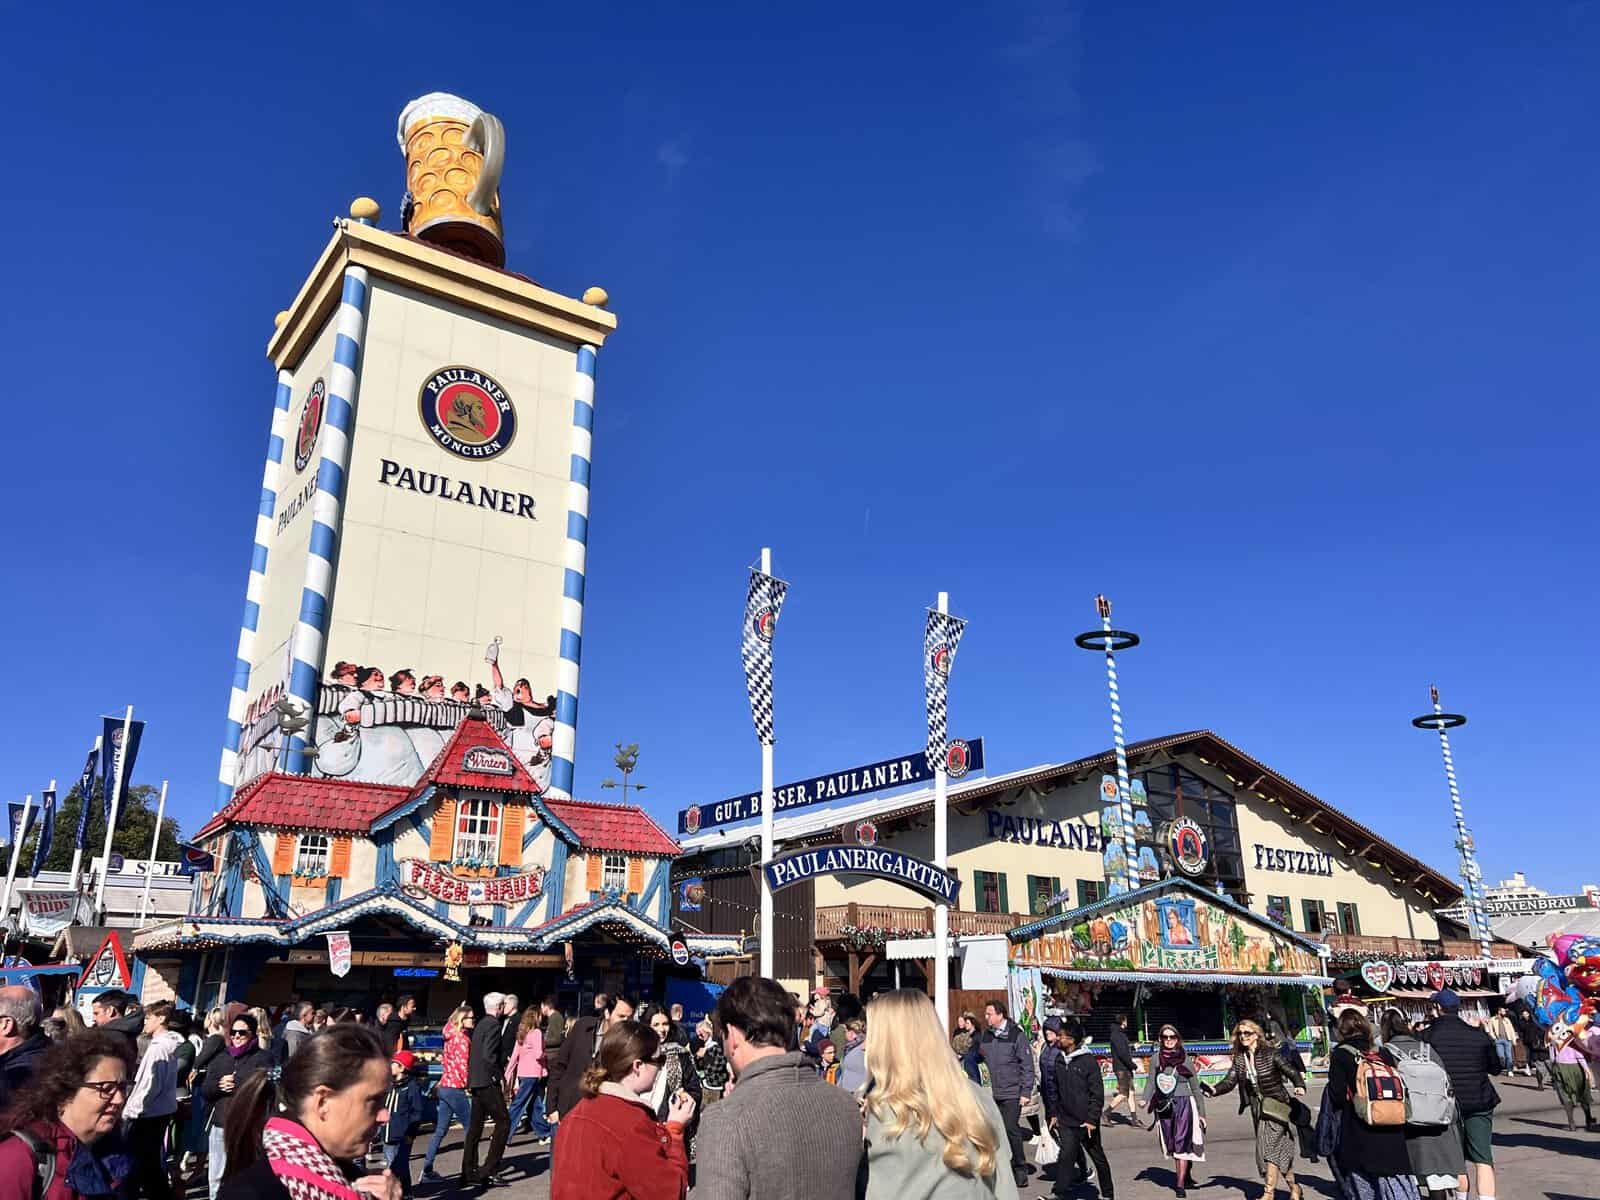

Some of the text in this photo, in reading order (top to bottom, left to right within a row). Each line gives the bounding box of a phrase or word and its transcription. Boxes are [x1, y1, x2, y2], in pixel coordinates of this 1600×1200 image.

[427, 369, 510, 413] PAULANER
[277, 467, 320, 537] PAULANE
[378, 458, 537, 520] PAULANER
[714, 760, 921, 822] GUT, BSSER, PAULANER.
[771, 848, 955, 898] PAULANERGARTEN
[1253, 843, 1334, 877] FESTZELT
[28, 900, 72, 915] Chips
[484, 872, 541, 902] HAUS
